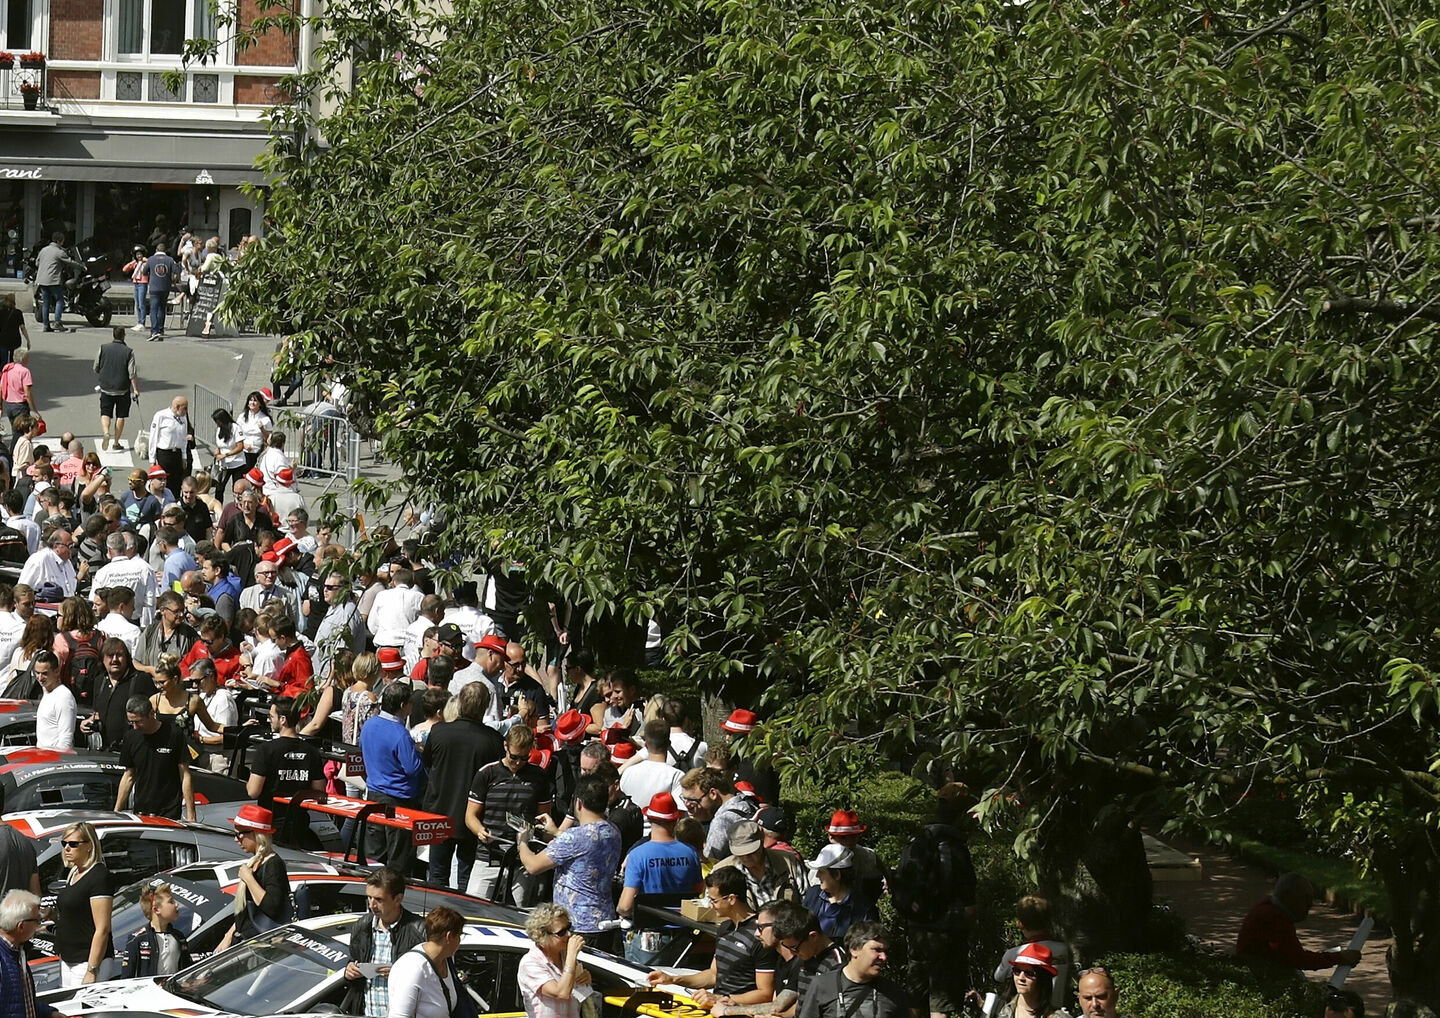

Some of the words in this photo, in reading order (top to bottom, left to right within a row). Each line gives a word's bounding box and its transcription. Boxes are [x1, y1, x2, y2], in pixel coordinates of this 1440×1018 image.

[195, 176, 214, 185] SPA
[278, 769, 309, 781] TEAM
[415, 821, 453, 831] TOTAL
[286, 931, 351, 964] BLANCPAIN
